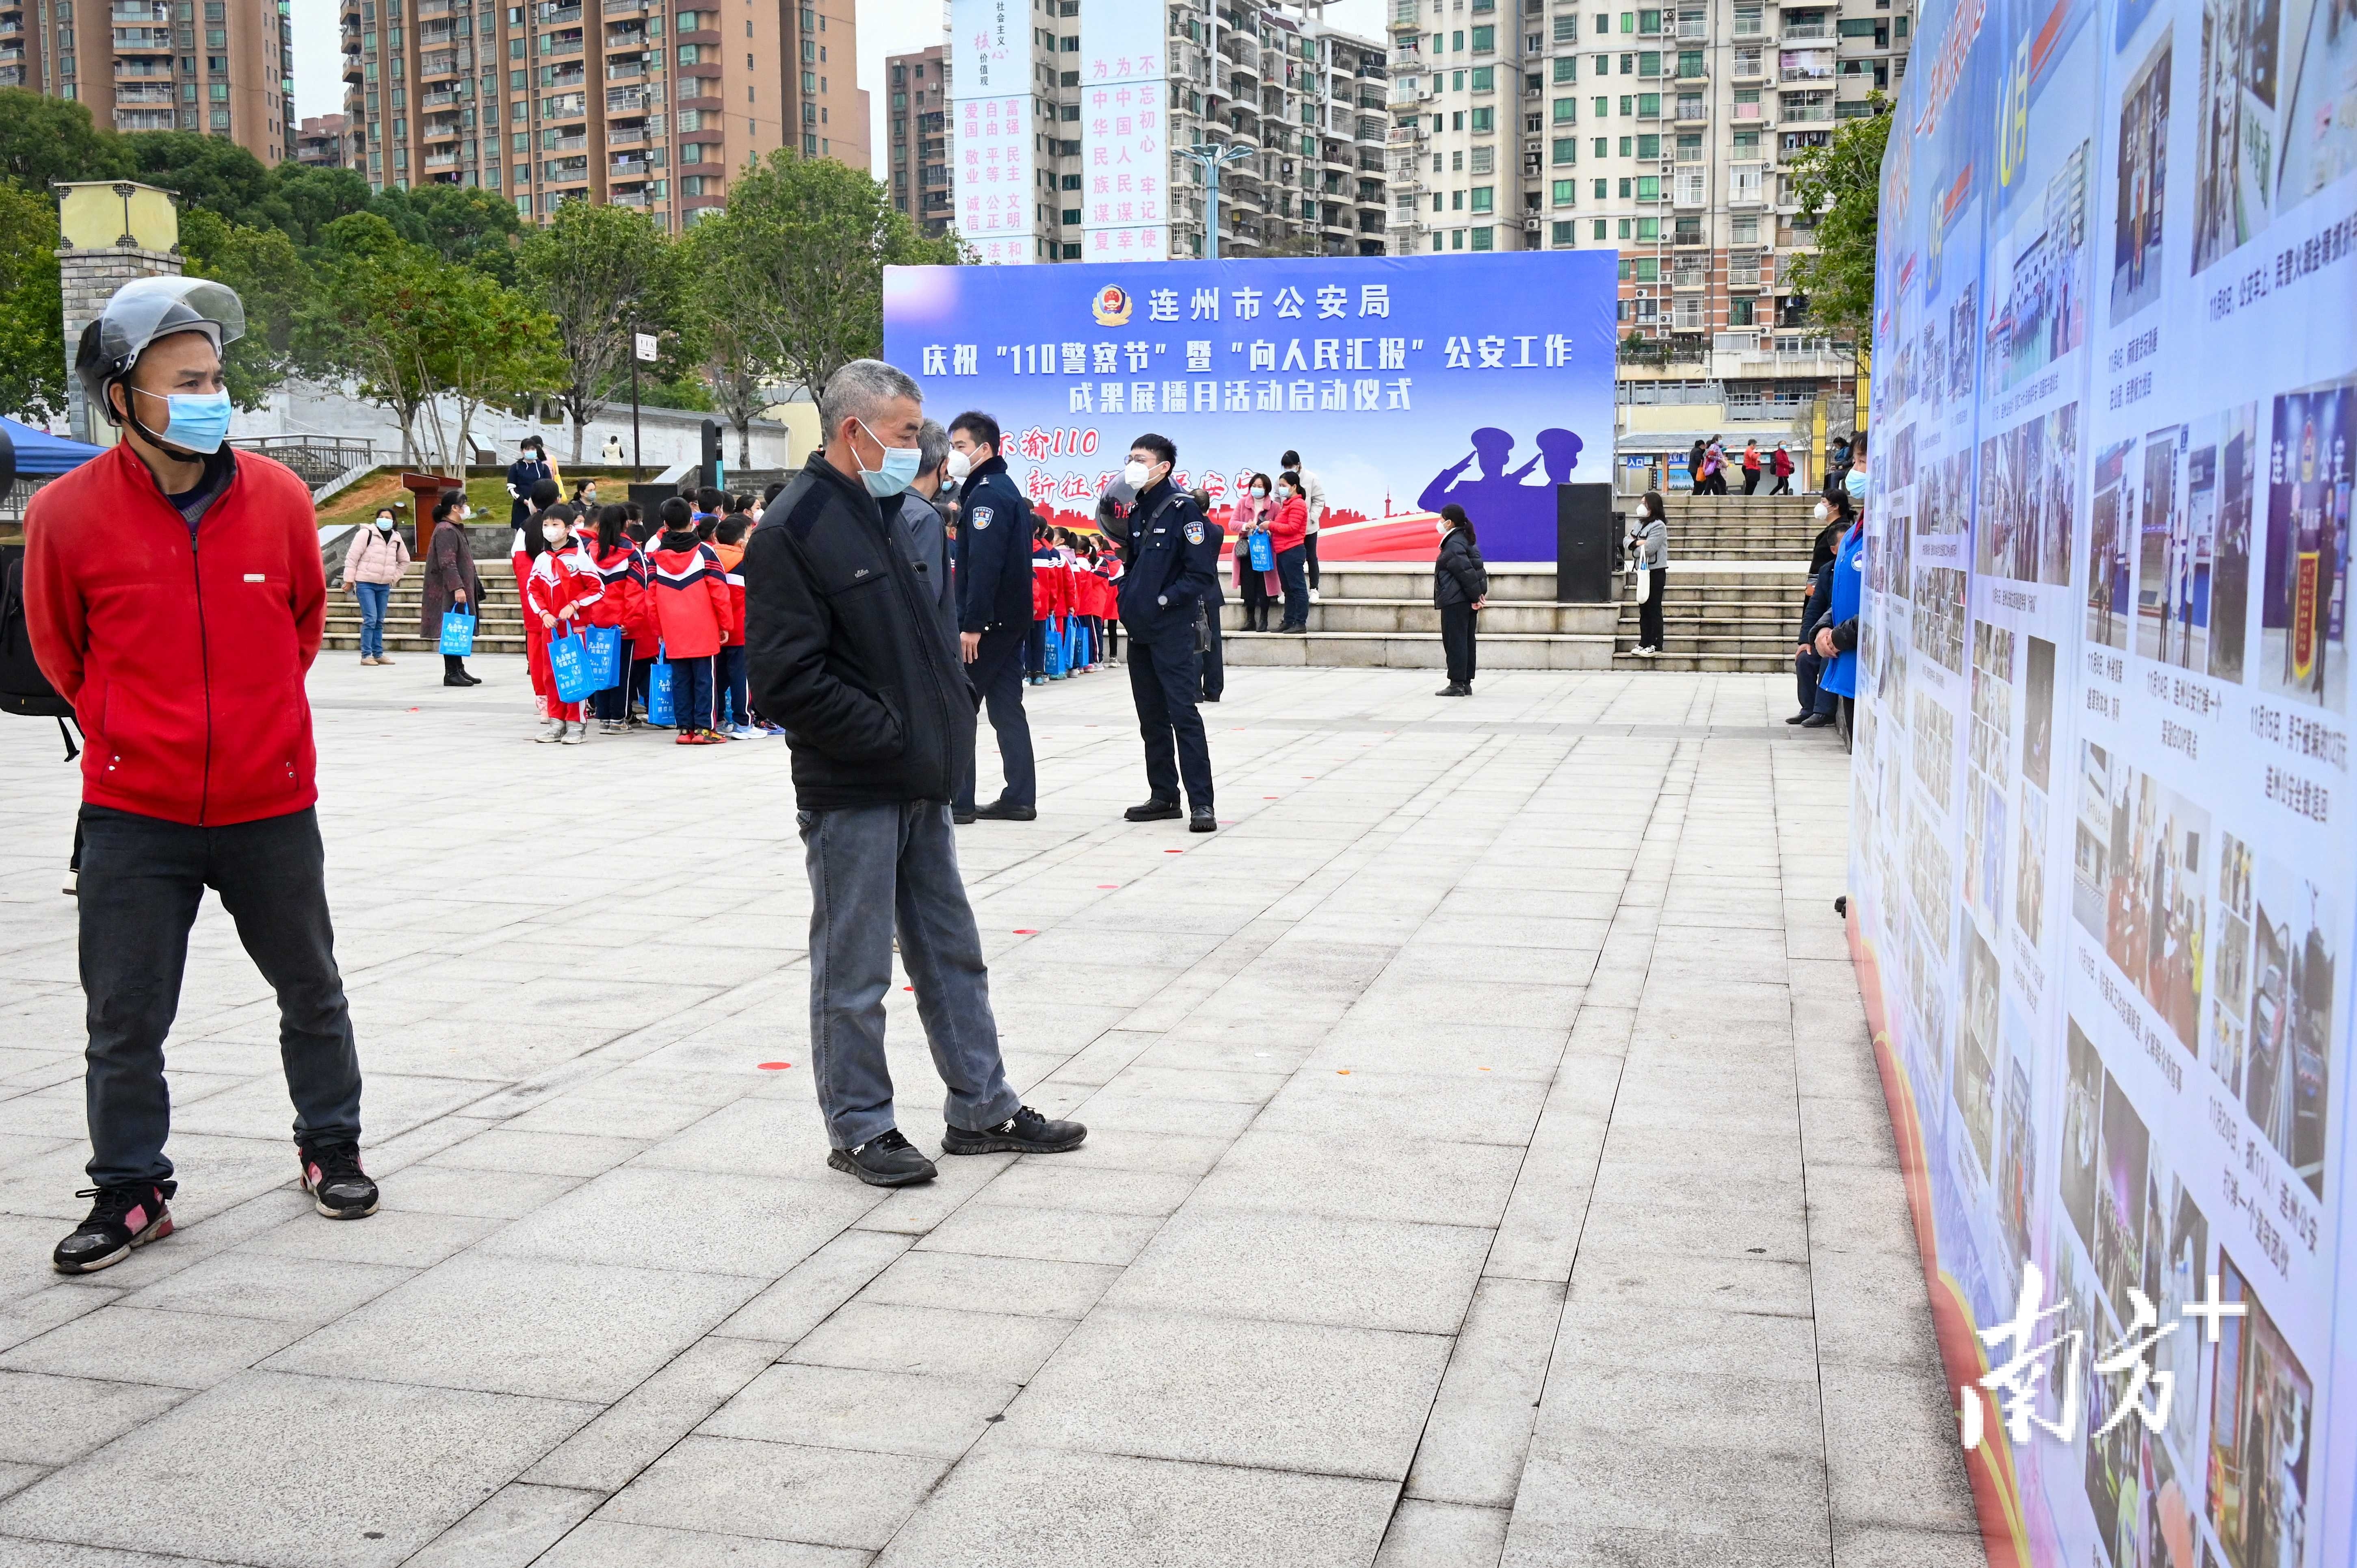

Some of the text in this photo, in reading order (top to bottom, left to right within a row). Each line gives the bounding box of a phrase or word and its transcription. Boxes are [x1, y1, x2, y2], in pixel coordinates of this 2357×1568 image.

[996, 1, 1005, 46] 社会主义
[974, 30, 1009, 59] 核心
[980, 53, 988, 86] 价值观
[964, 102, 978, 138] 爱国
[986, 101, 998, 136] 自由
[1006, 99, 1019, 135] 富强
[1139, 56, 1155, 154] 不忘初心
[965, 149, 979, 184] 敬业
[986, 149, 1000, 183] 平等
[1007, 146, 1020, 181] 民主
[1093, 60, 1110, 262] 为中华民族谋复
[966, 195, 980, 231] 诚信
[986, 194, 1000, 229] 公正
[1007, 193, 1020, 228] 文明
[1149, 284, 1390, 322] 连州市公安局
[1069, 378, 1412, 414] 成果展播月活动启动仪式
[1628, 458, 1643, 467] 入口
